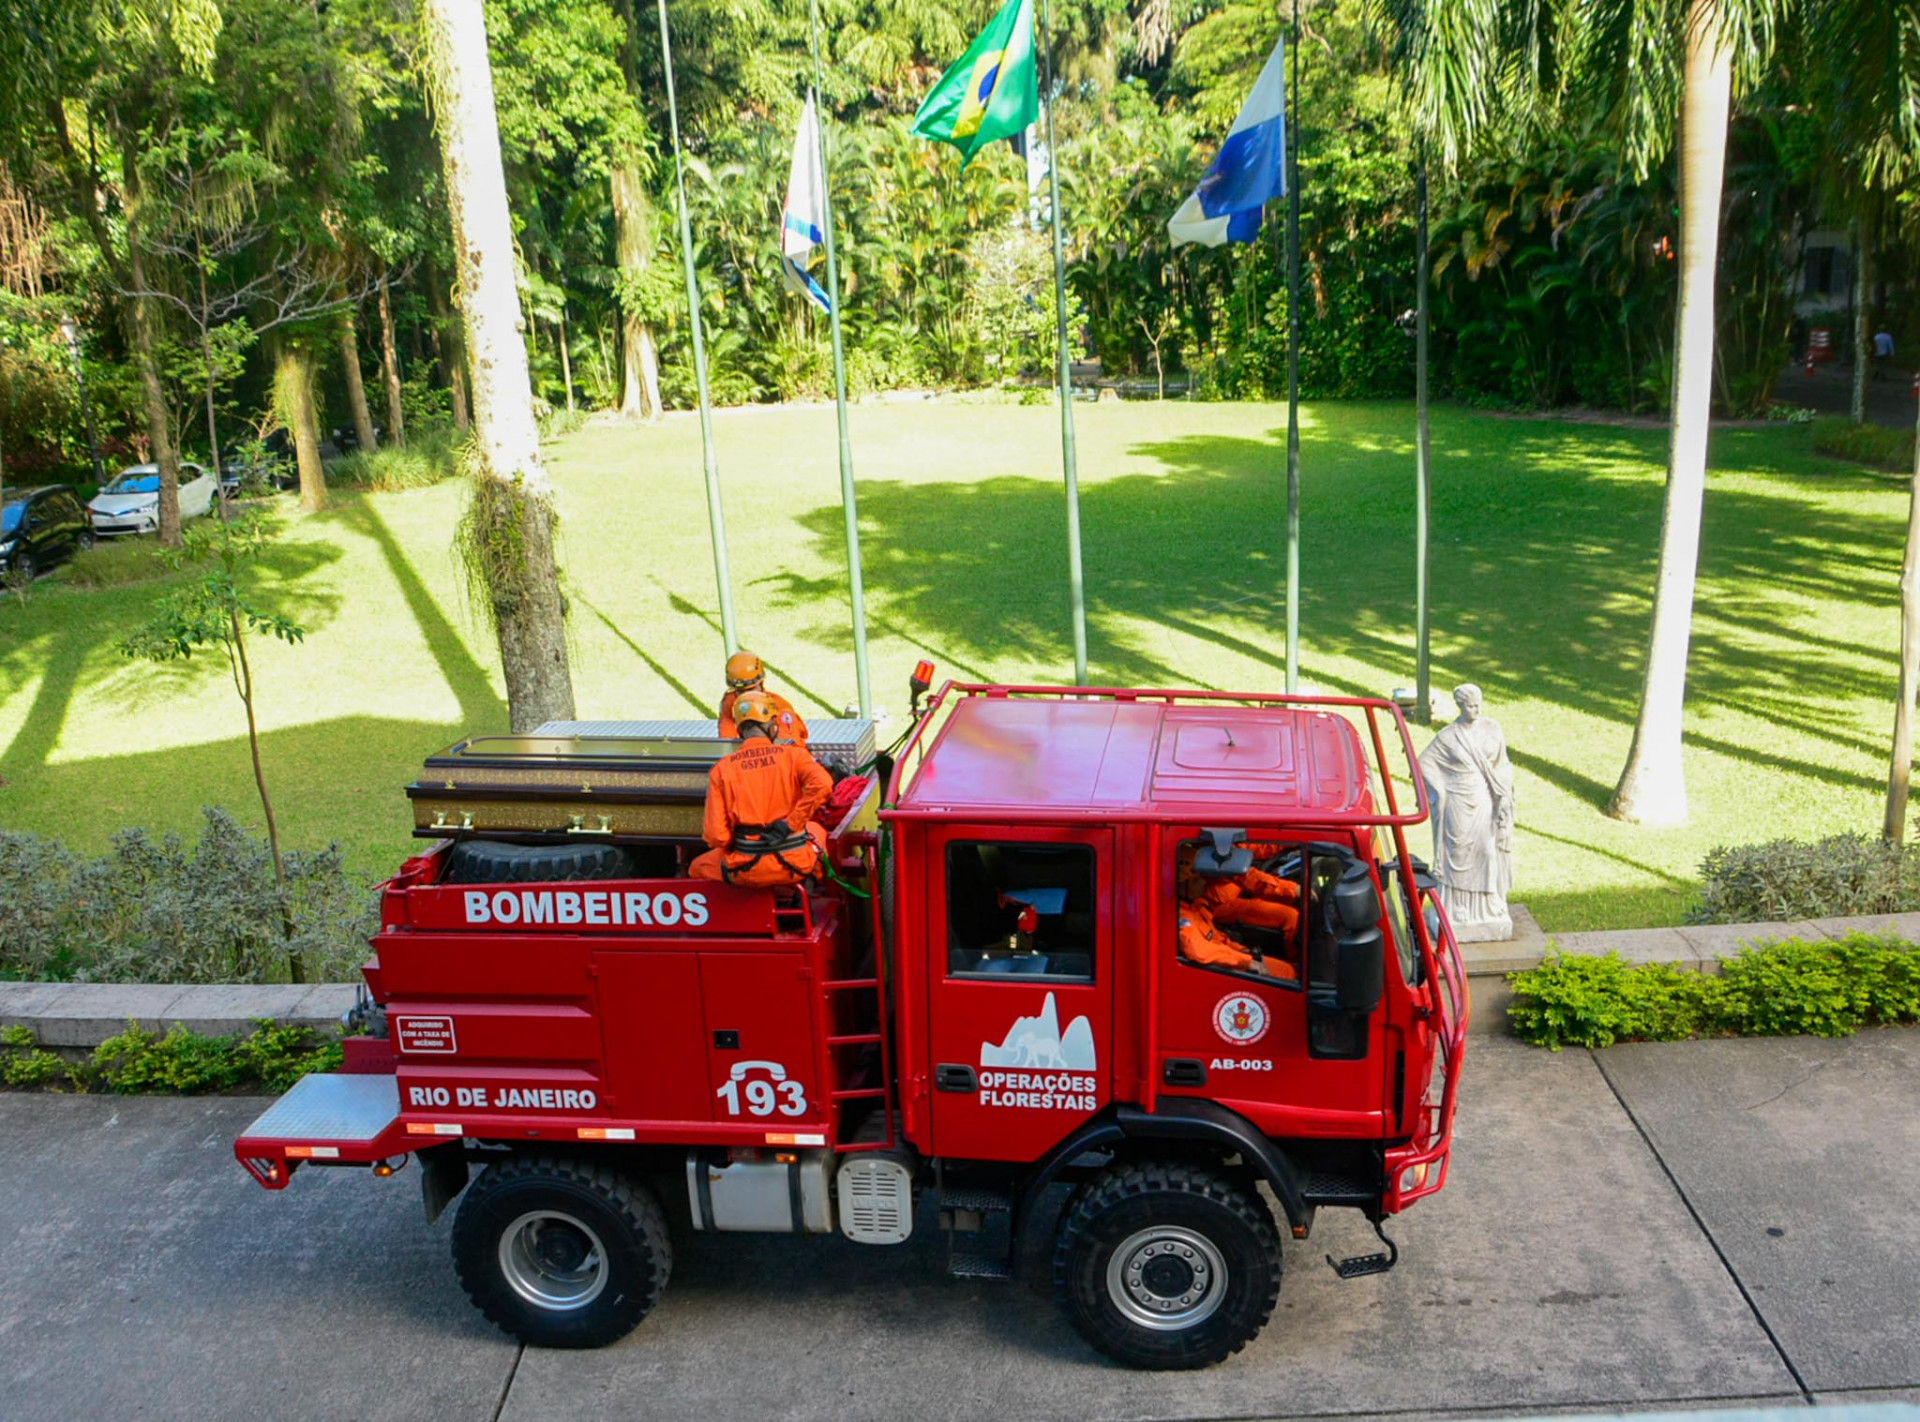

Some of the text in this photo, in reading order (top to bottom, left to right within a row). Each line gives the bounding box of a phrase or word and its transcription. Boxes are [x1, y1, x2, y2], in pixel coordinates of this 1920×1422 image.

[730, 746, 784, 763] BOMBEIROS
[741, 755, 776, 770] GSFMA
[463, 891, 709, 926] BOMBEIROS
[1210, 1058, 1273, 1071] AB-003
[980, 1071, 1096, 1094] OPERAÇÕES
[409, 1087, 597, 1109] RIO DE JANEIRO
[717, 1080, 807, 1116] 193
[980, 1090, 1097, 1111] FLORESTAIS
